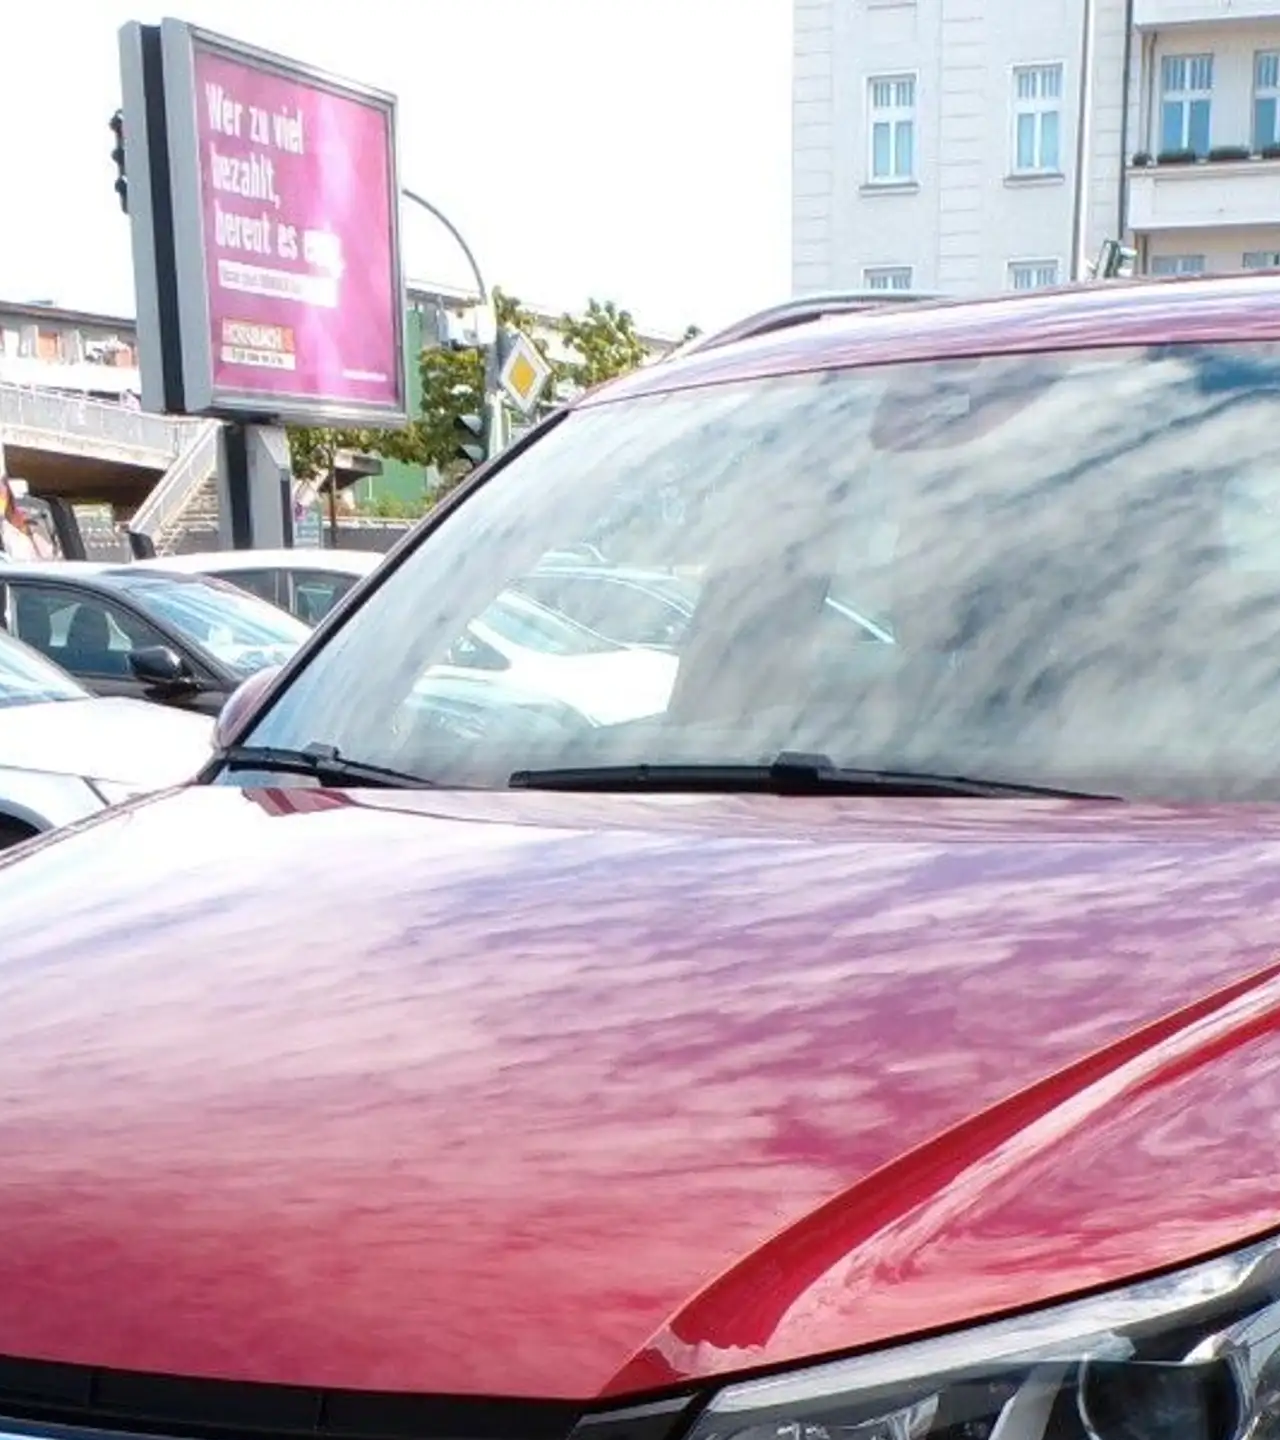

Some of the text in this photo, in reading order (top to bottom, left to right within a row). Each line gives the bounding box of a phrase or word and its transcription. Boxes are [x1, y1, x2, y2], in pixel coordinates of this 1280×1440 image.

[205, 82, 303, 155] Wer zu viel
[209, 140, 280, 210] bezahlt,
[214, 199, 271, 255] bereut
[277, 222, 298, 260] es
